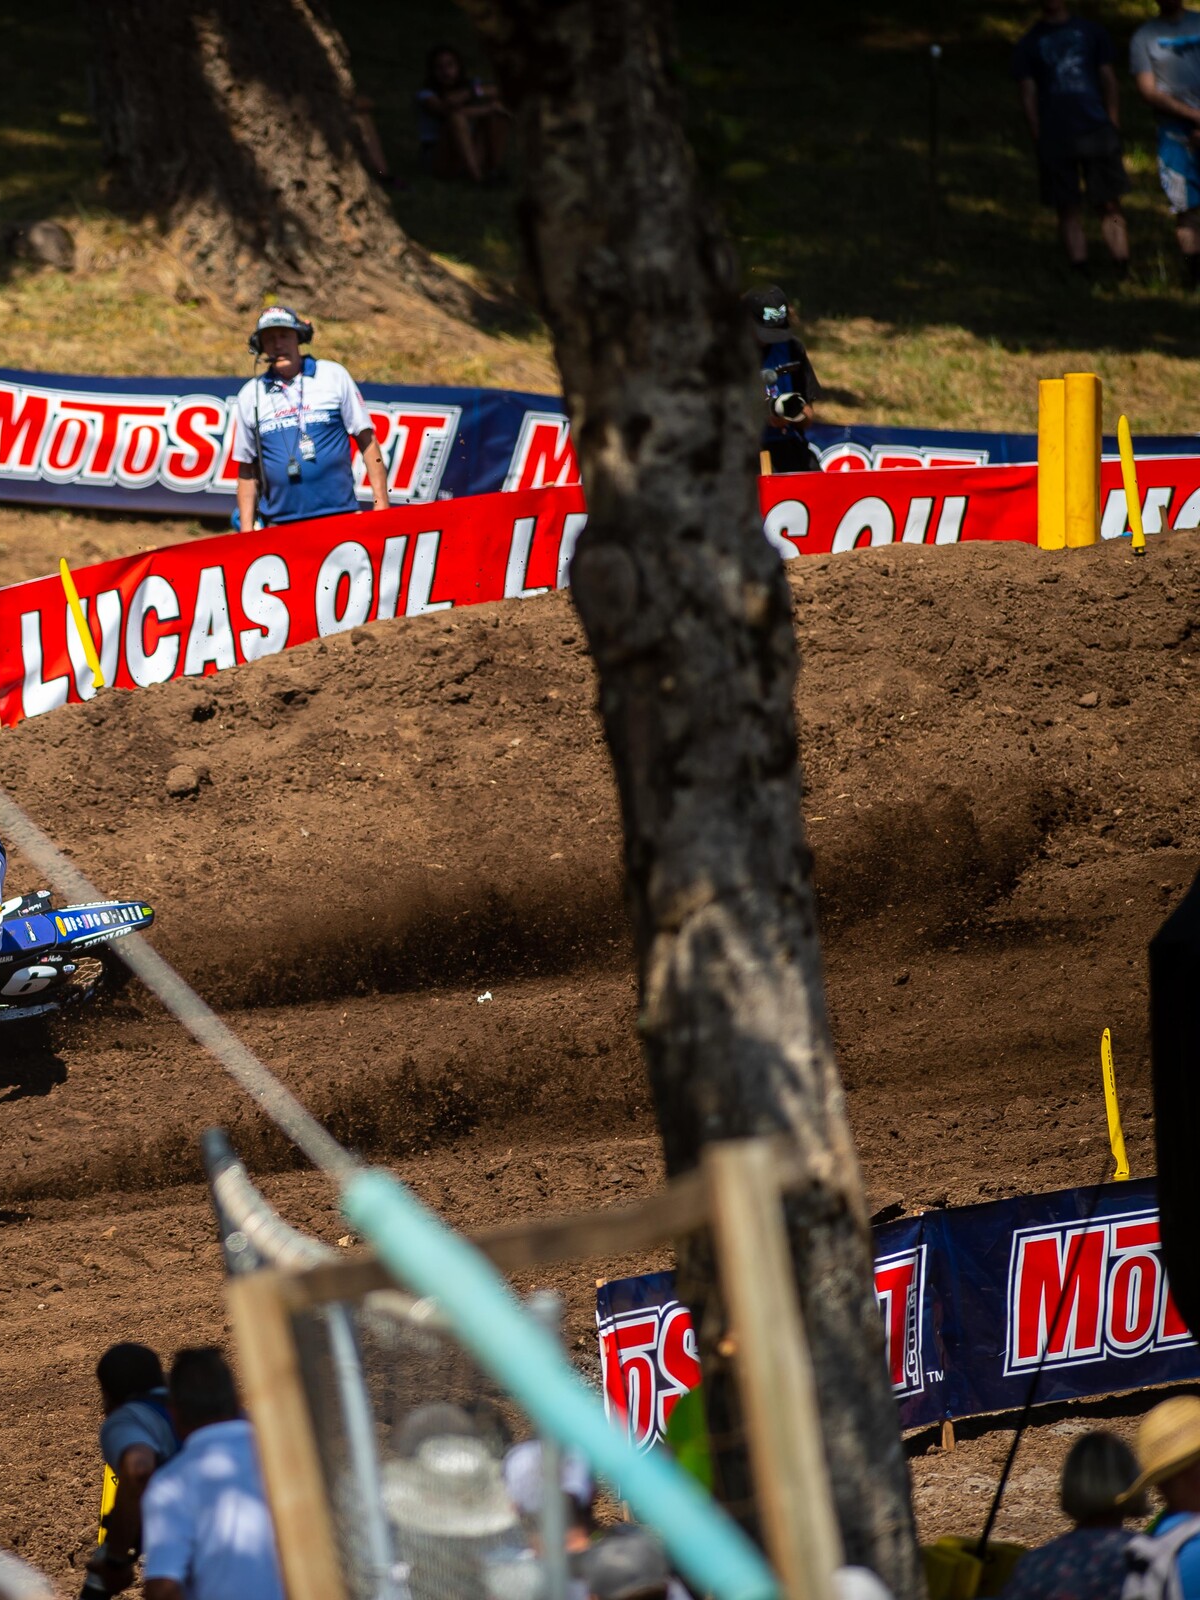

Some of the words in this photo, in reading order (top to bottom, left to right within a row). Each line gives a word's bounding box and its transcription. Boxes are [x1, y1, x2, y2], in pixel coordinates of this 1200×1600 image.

[20, 553, 291, 718] LUCAS
[315, 530, 454, 638] OIL
[84, 926, 132, 949] DUNLOP
[0, 965, 58, 996] 6
[926, 1370, 944, 1384] TM
